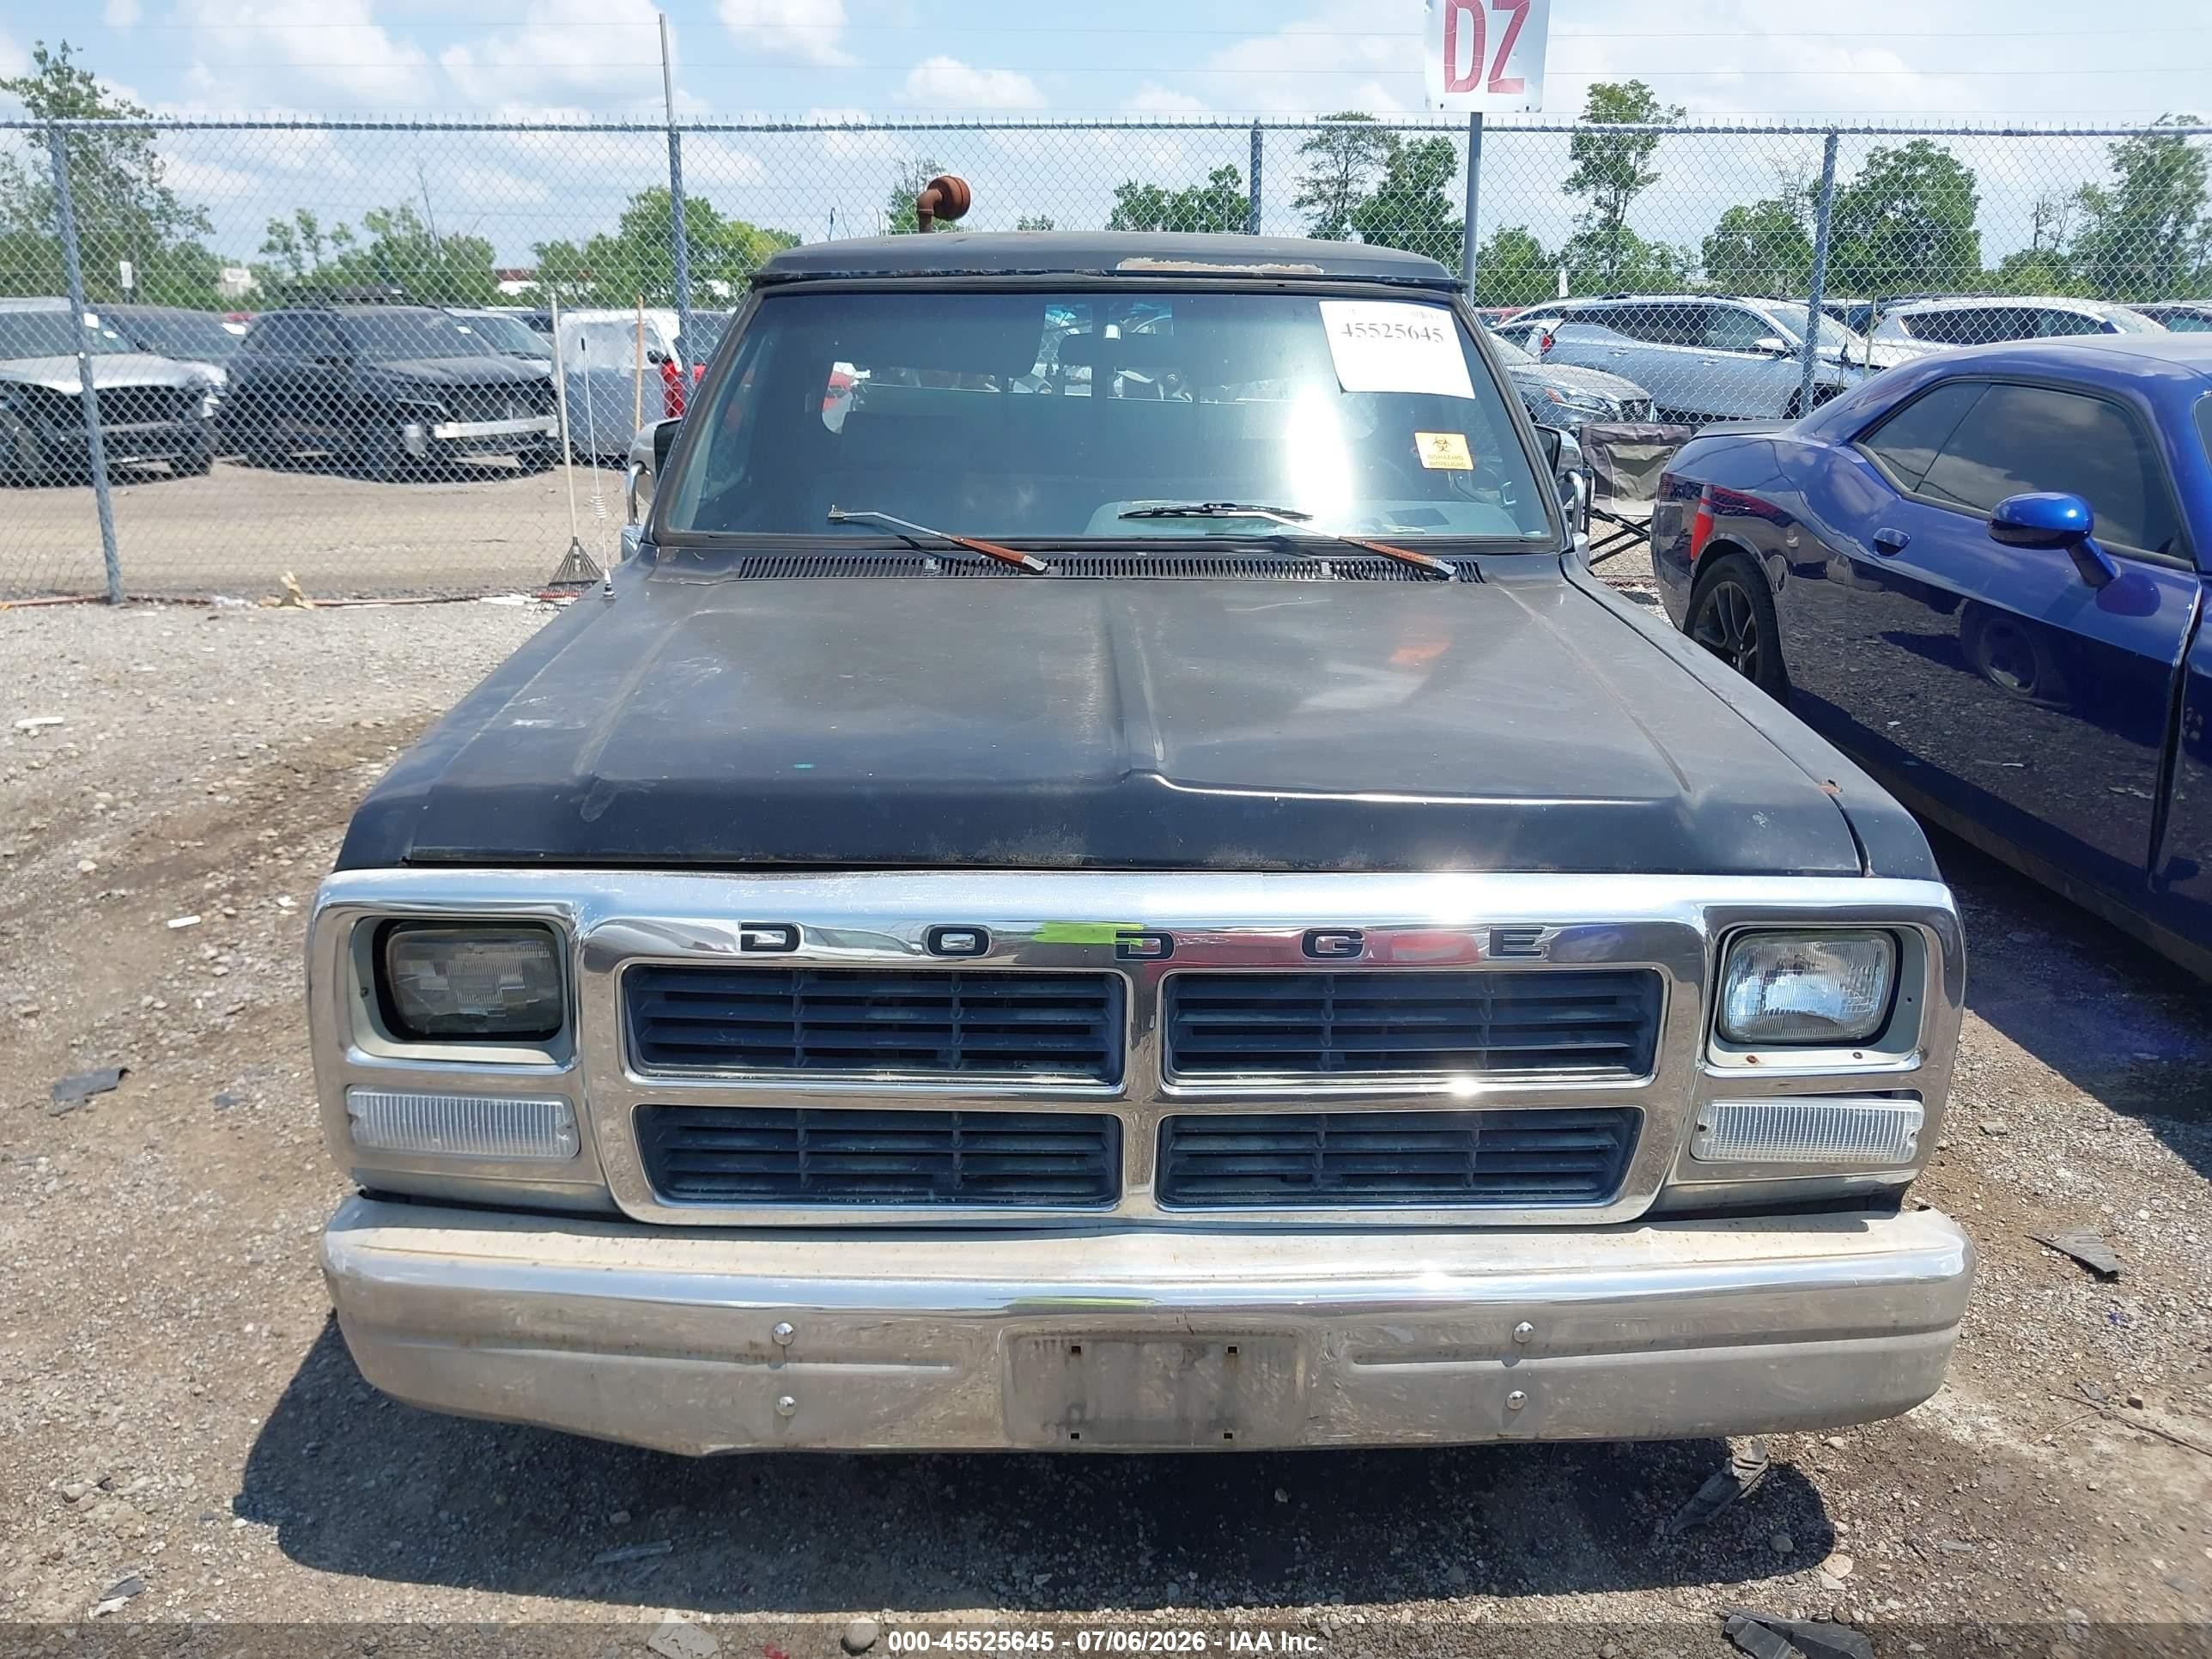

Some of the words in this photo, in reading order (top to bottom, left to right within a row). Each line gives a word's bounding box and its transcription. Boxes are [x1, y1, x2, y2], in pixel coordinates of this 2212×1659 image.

[1444, 0, 1530, 94] DZ
[1340, 322, 1444, 343] 45525645
[739, 921, 1546, 960] DODGE
